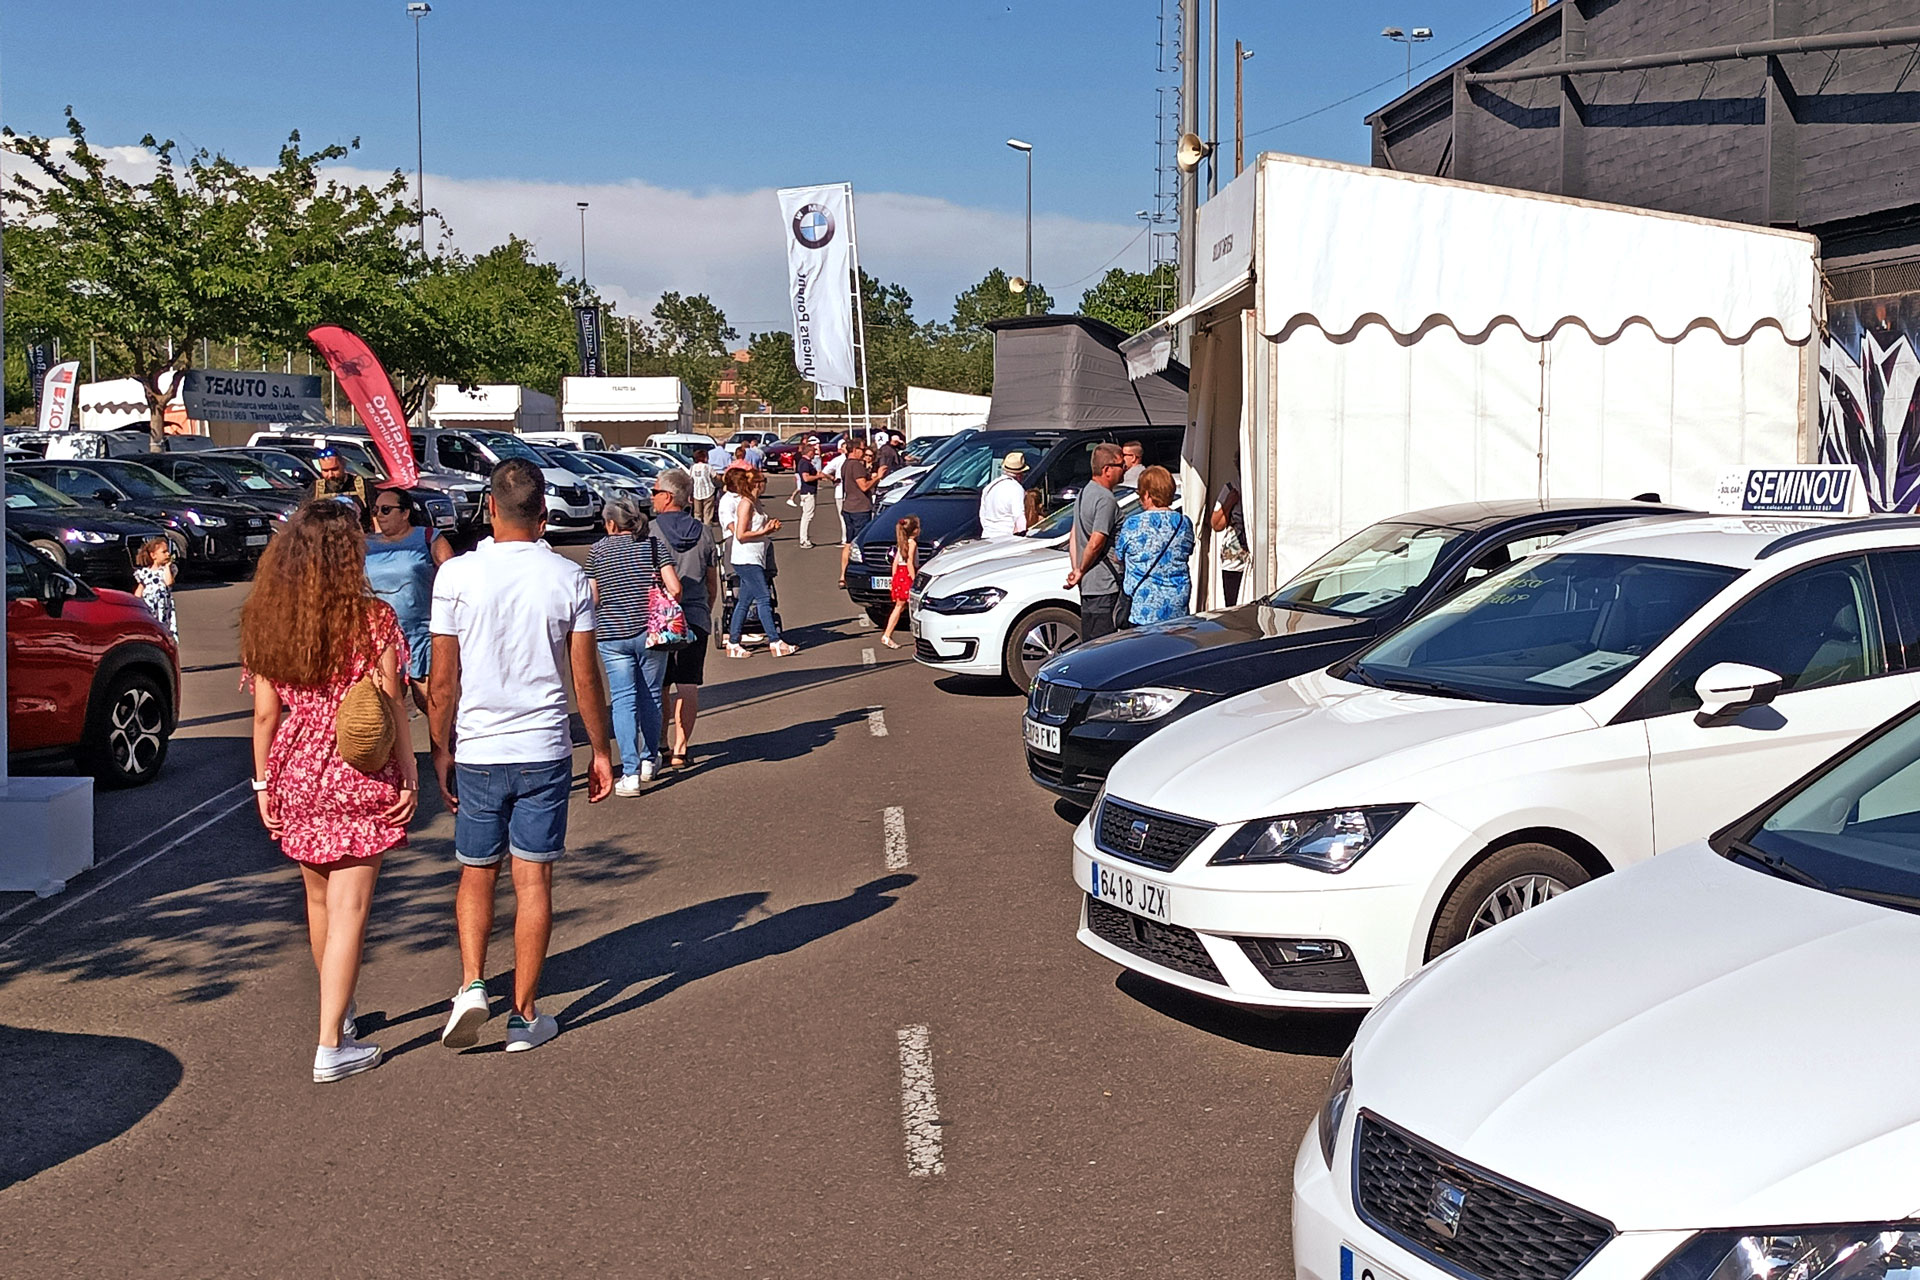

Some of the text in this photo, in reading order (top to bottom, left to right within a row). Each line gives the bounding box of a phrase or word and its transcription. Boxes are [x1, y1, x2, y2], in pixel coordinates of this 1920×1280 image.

[205, 376, 295, 398] TEAUTO S.A.
[1747, 470, 1847, 505] SEMINOU
[1101, 869, 1165, 918] 6418 JZX
